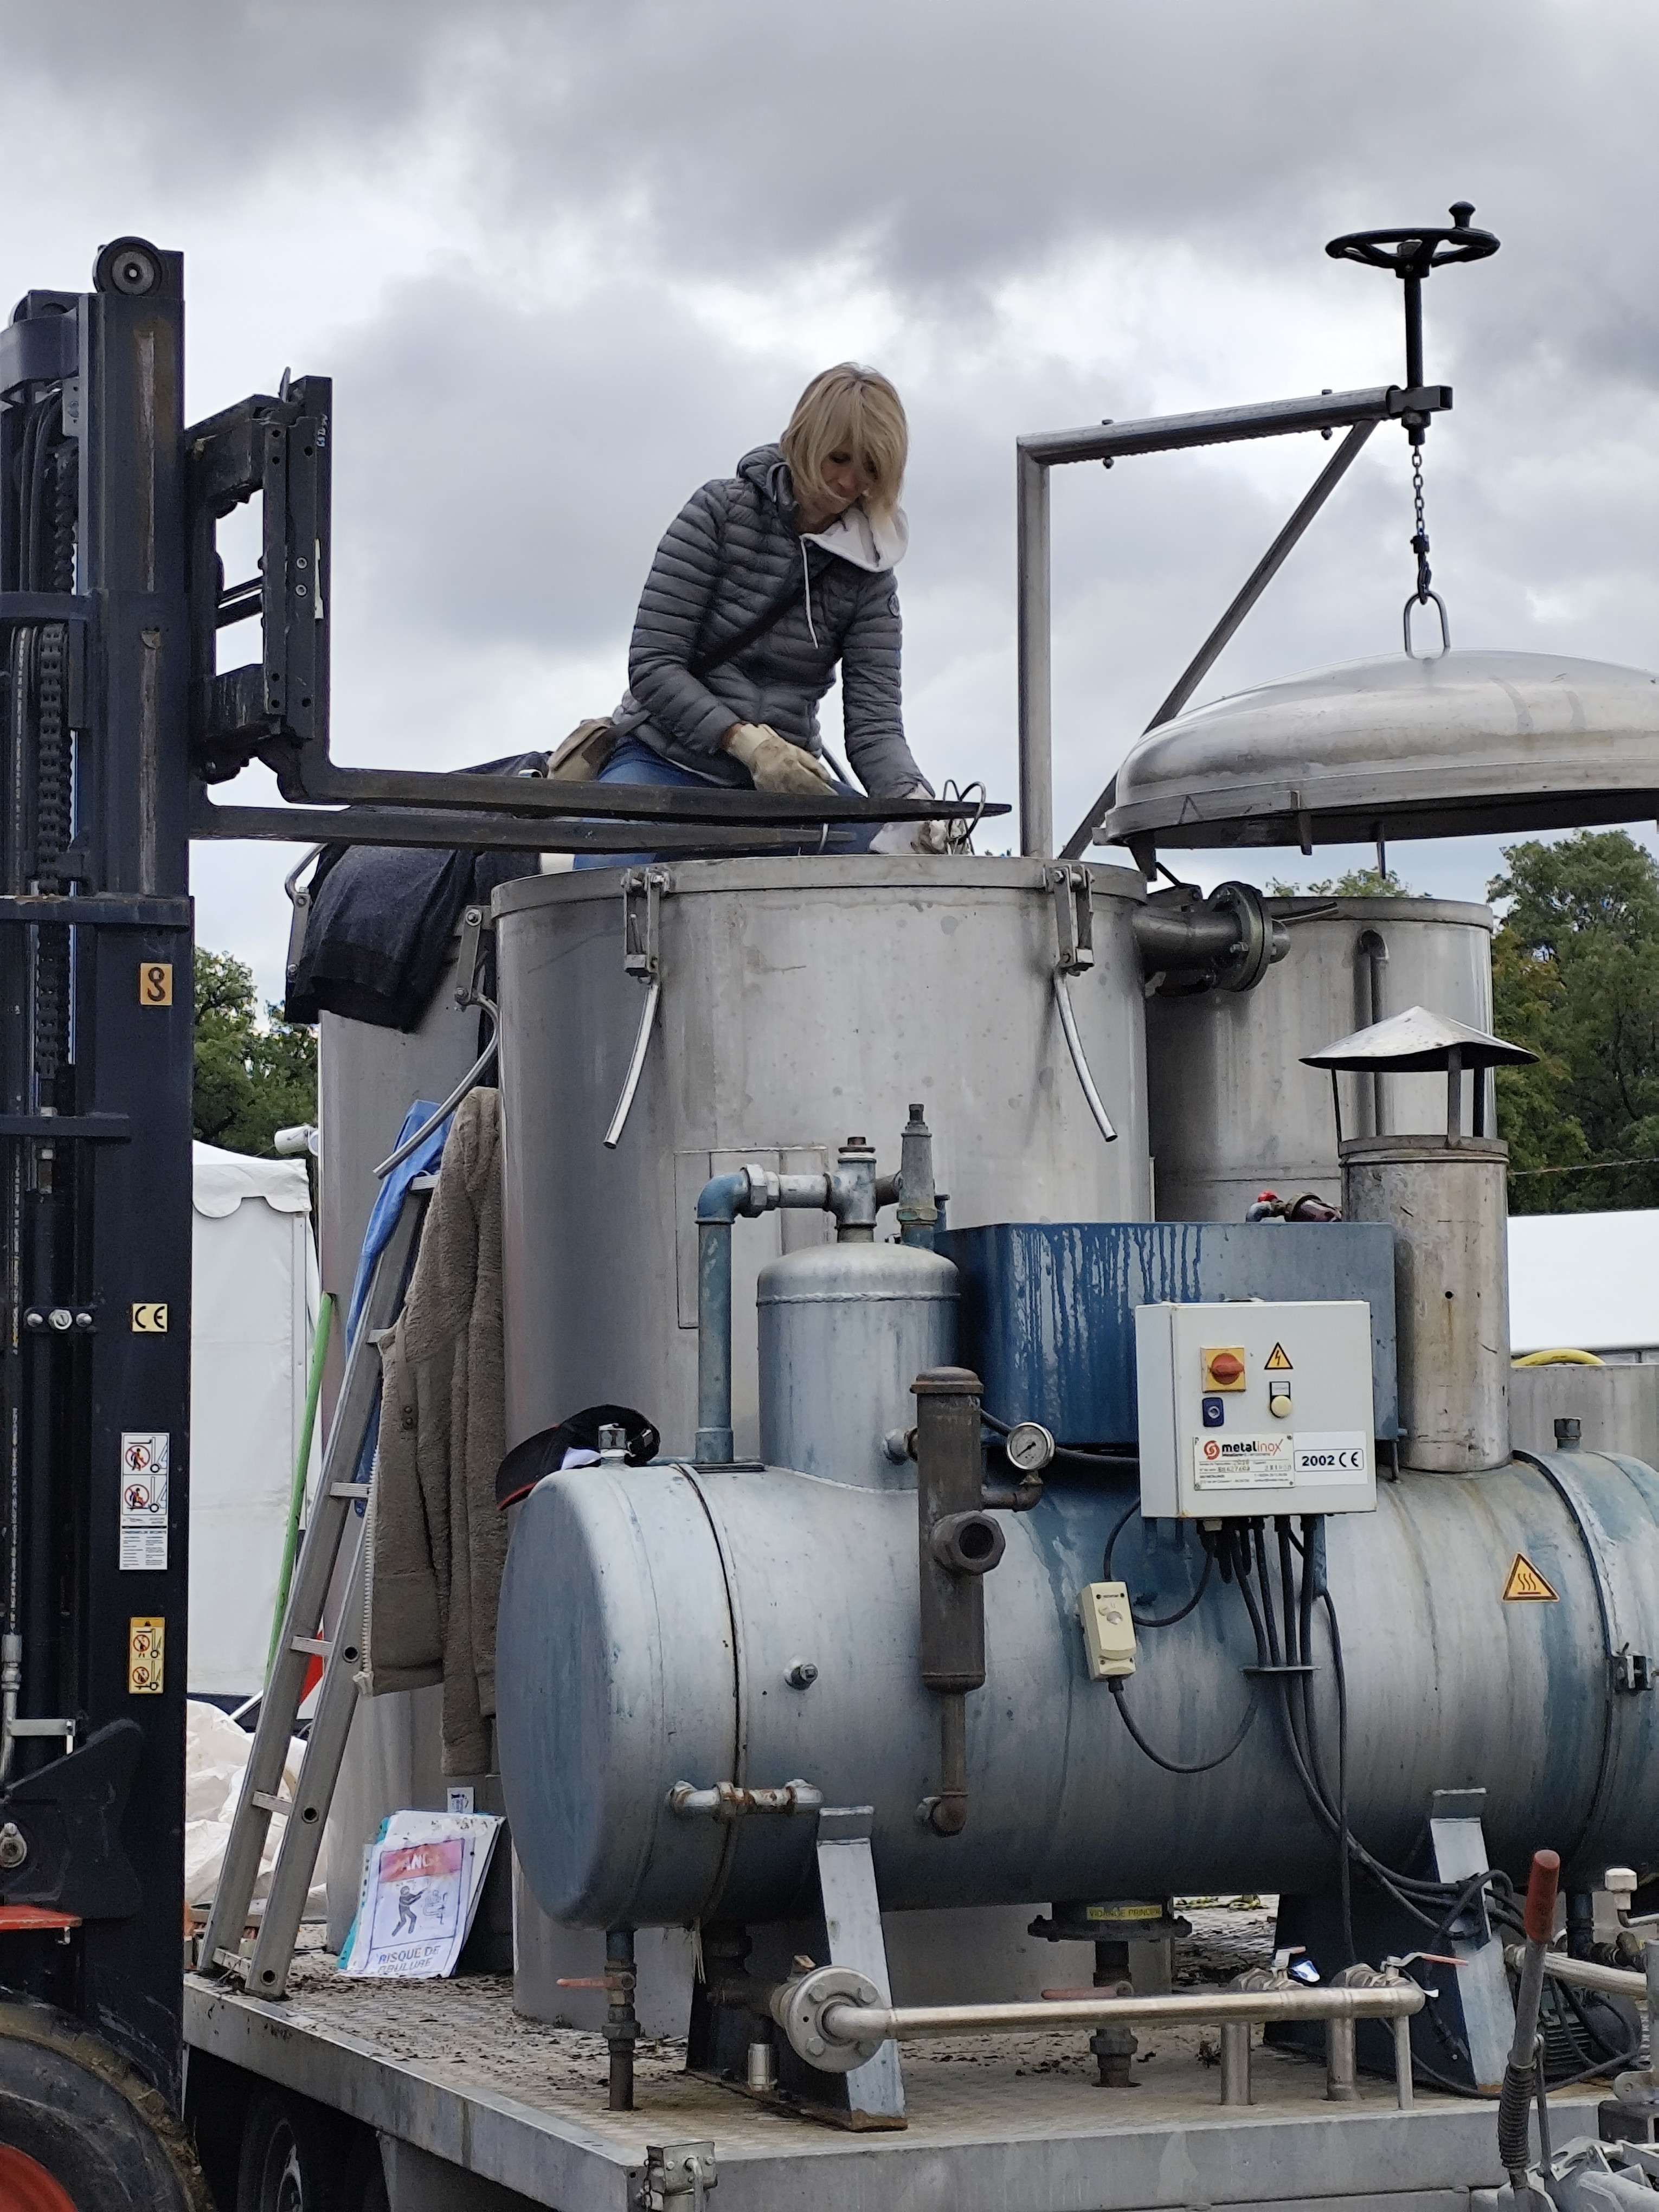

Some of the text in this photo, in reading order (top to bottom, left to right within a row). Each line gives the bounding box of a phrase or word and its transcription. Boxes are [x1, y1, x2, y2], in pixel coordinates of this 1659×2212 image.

[135, 1306, 165, 1329] CE
[1222, 1439, 1283, 1455] metalinox
[1302, 1452, 1359, 1467] 2002 CE
[378, 1945, 441, 1964] RISQUE DE
